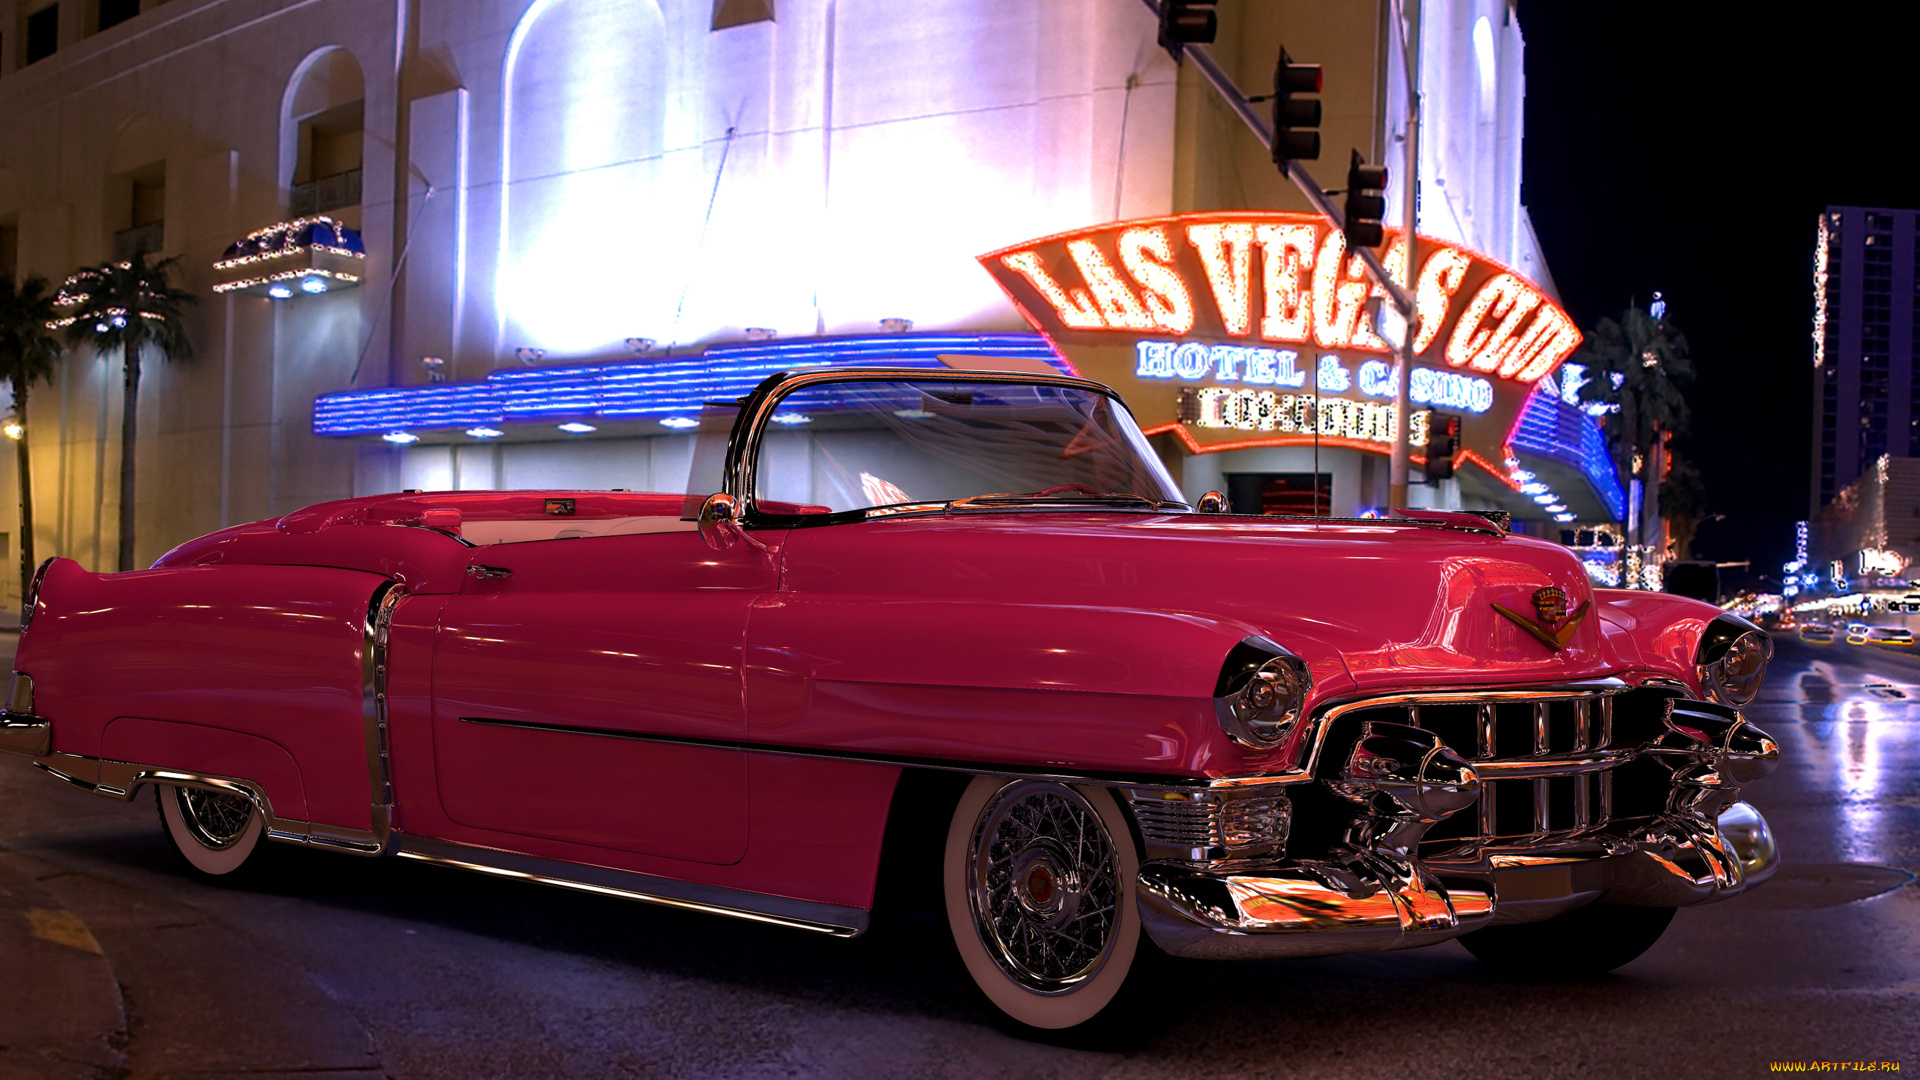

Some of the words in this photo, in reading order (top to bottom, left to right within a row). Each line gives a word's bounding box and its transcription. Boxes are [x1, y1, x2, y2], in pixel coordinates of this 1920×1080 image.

[1001, 225, 1195, 336] LAS
[1185, 221, 1474, 356] VEGAS
[1136, 340, 1306, 388] HOTEL
[1316, 354, 1351, 392] &
[1358, 359, 1494, 413] CASINO
